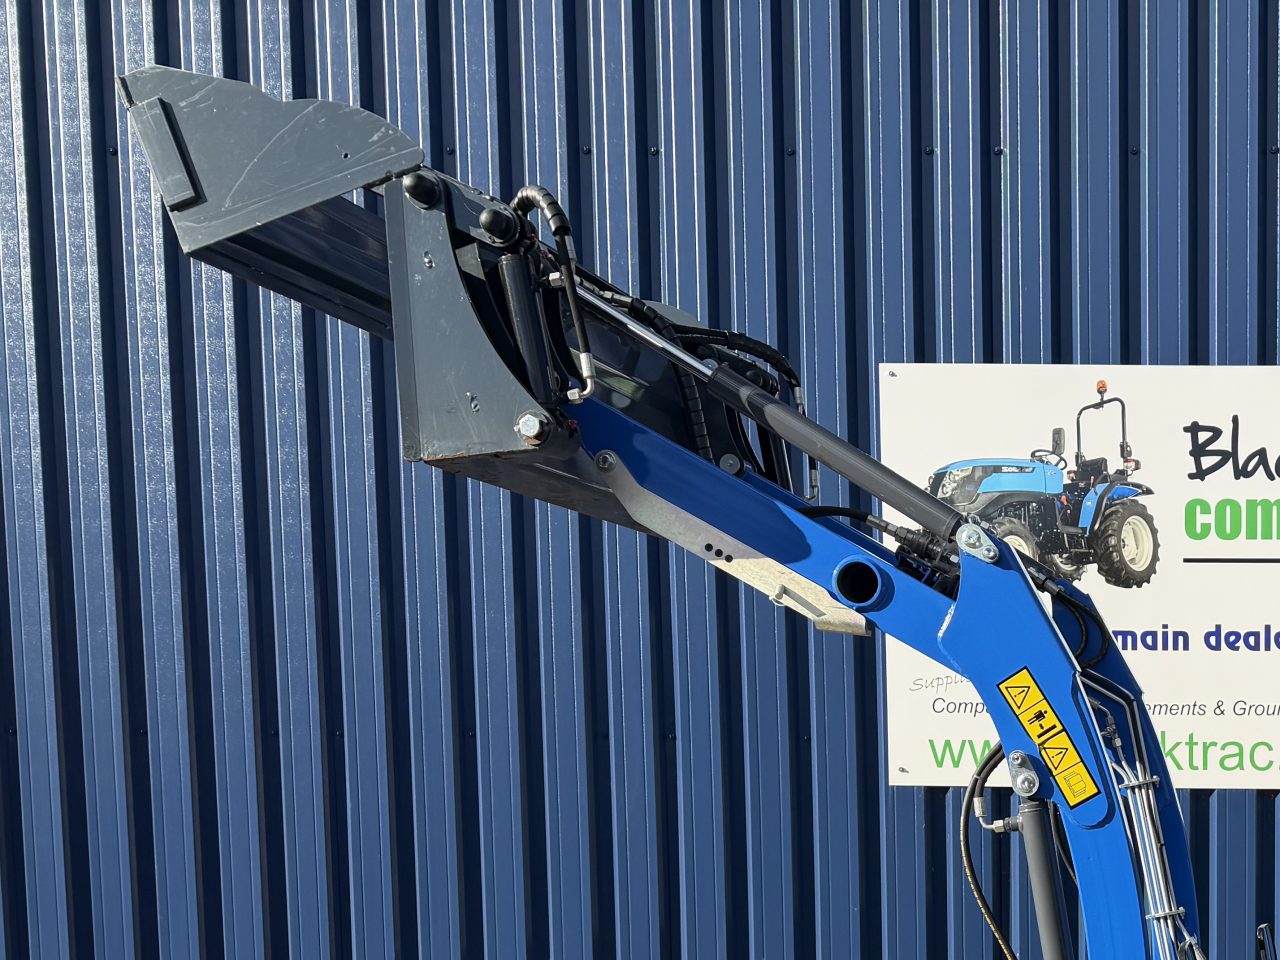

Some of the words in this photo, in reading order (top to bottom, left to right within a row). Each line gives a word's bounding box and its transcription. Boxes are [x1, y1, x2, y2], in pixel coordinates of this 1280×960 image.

[1111, 623, 1190, 651] main
[908, 673, 971, 695] Suppli
[932, 697, 990, 718] Comp
[1214, 700, 1226, 716] &
